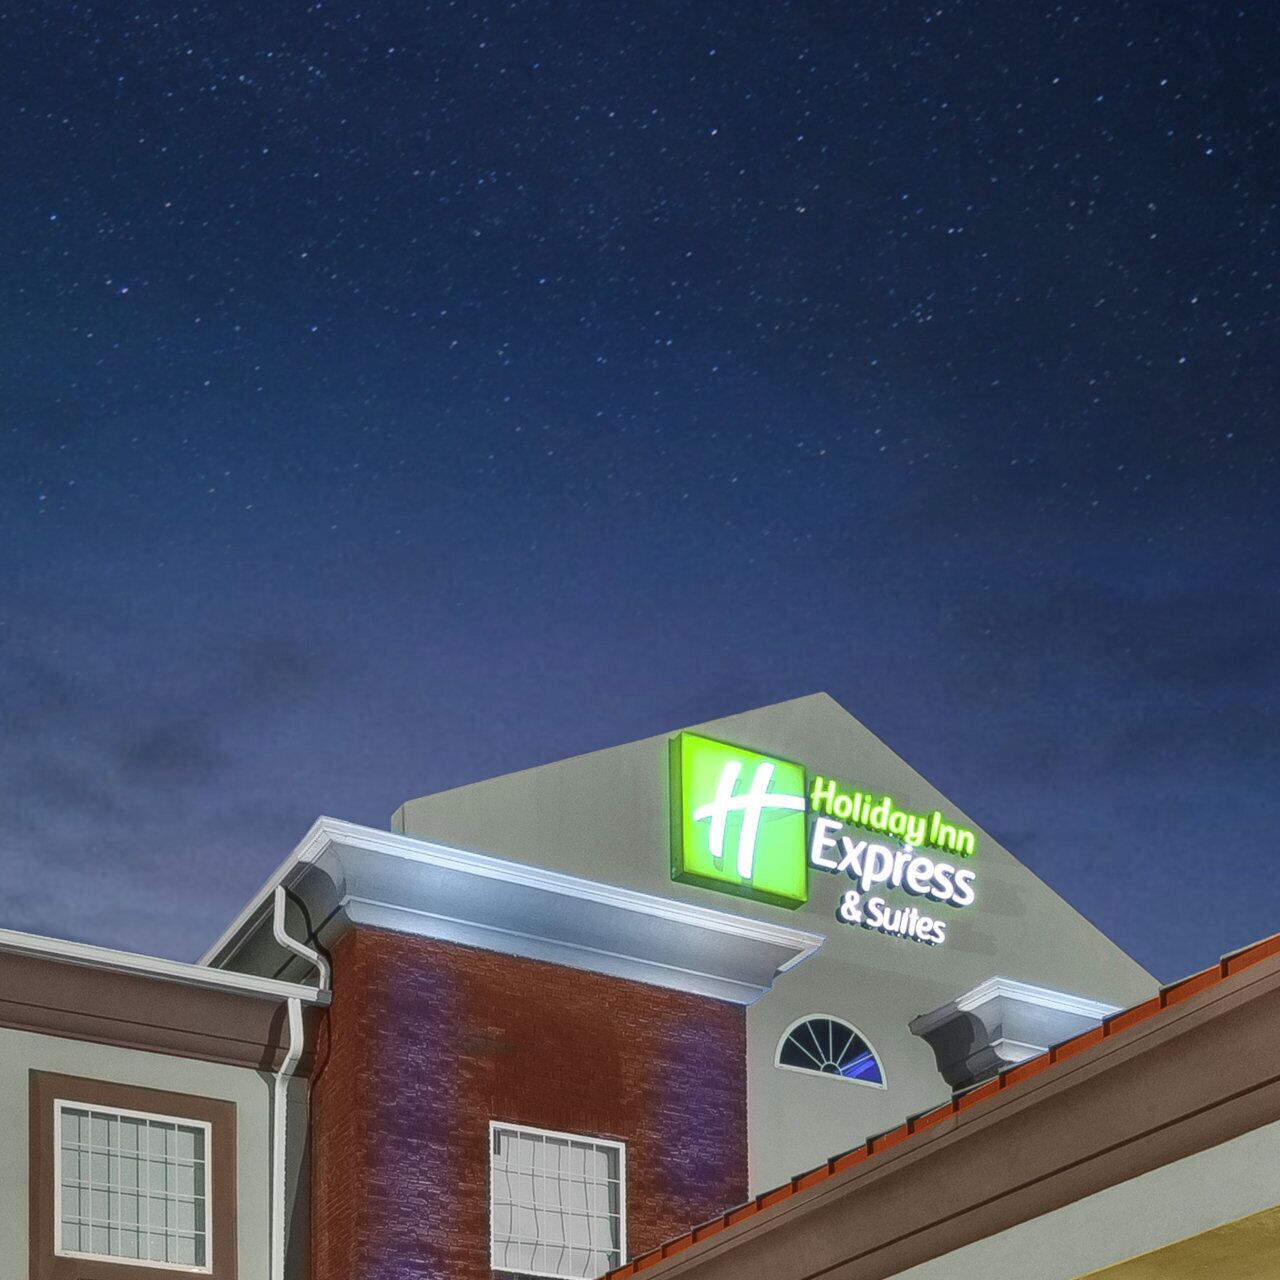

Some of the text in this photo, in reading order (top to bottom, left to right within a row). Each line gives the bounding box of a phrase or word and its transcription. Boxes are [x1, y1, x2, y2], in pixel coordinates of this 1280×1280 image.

[810, 775, 975, 855] Holiday Inn
[811, 817, 977, 906] Express
[840, 890, 946, 944] & Suites
